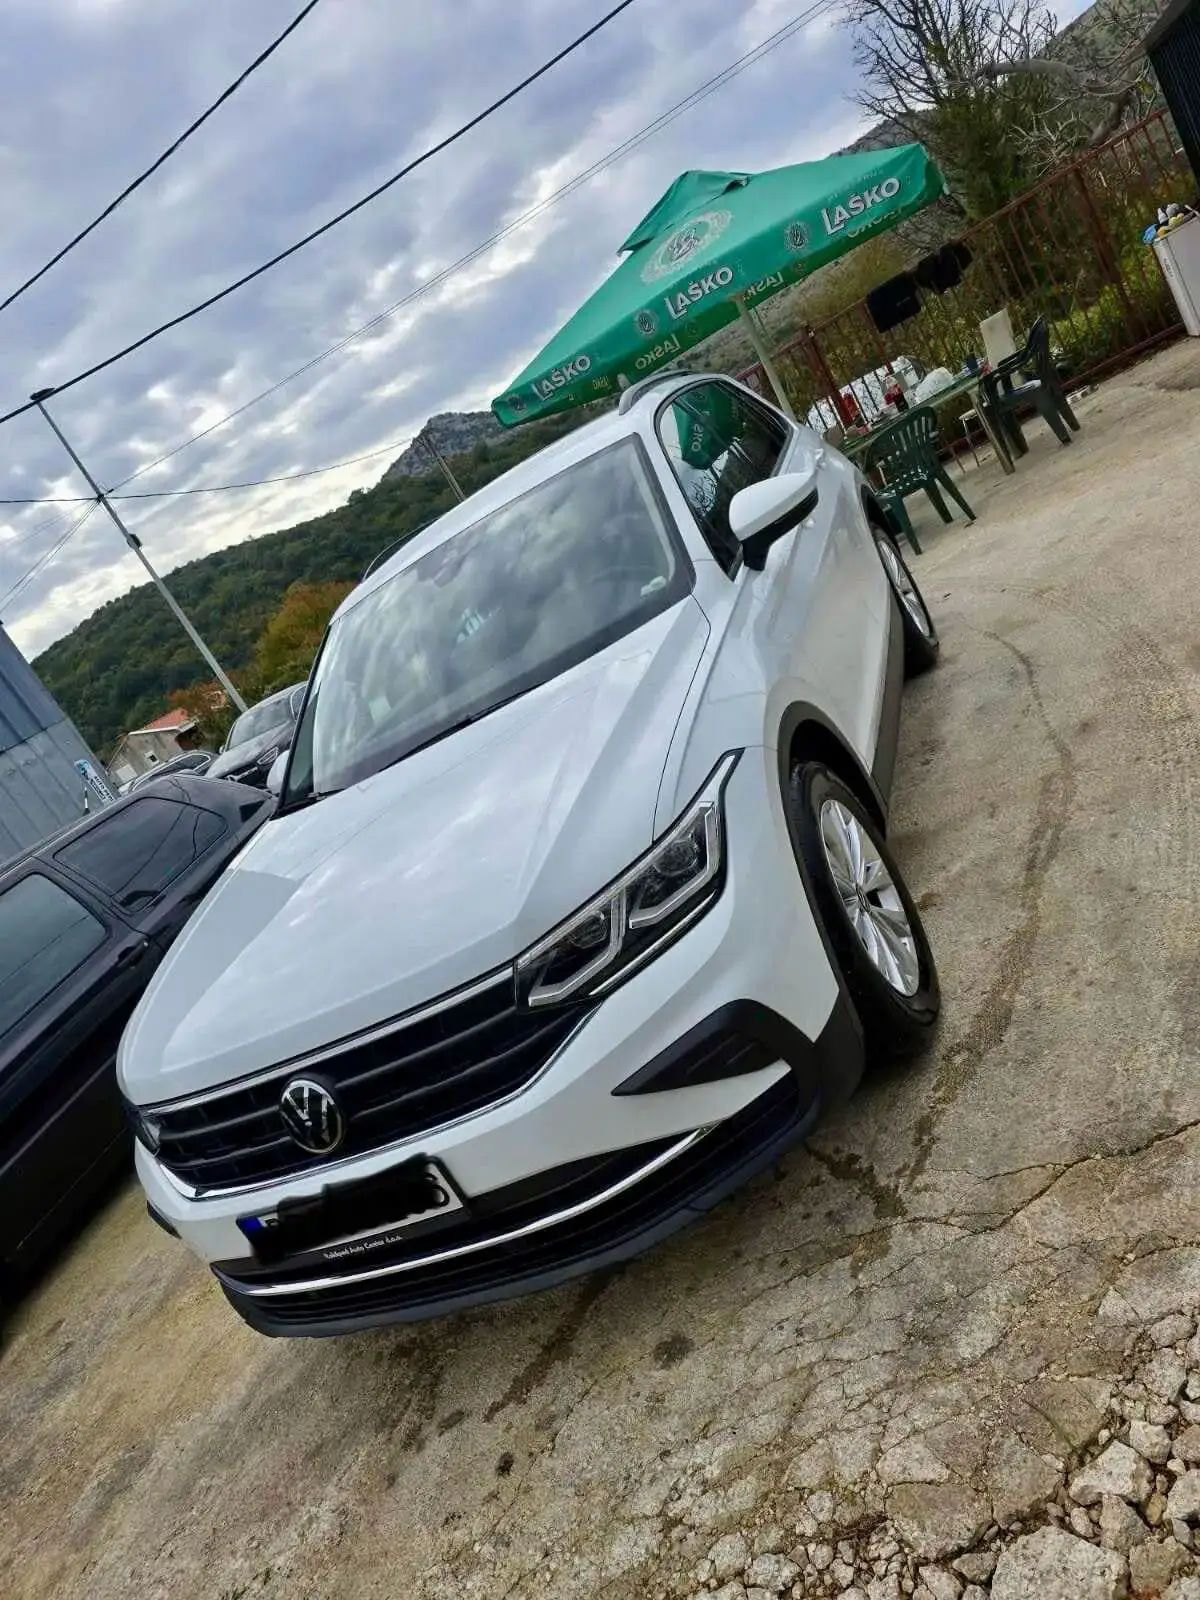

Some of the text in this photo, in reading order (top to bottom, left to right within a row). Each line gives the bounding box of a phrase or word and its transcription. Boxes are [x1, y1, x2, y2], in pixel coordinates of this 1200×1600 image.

[821, 177, 900, 235] LAŠKO
[664, 266, 733, 319] LAŠKO
[531, 355, 591, 401] LAŠKO
